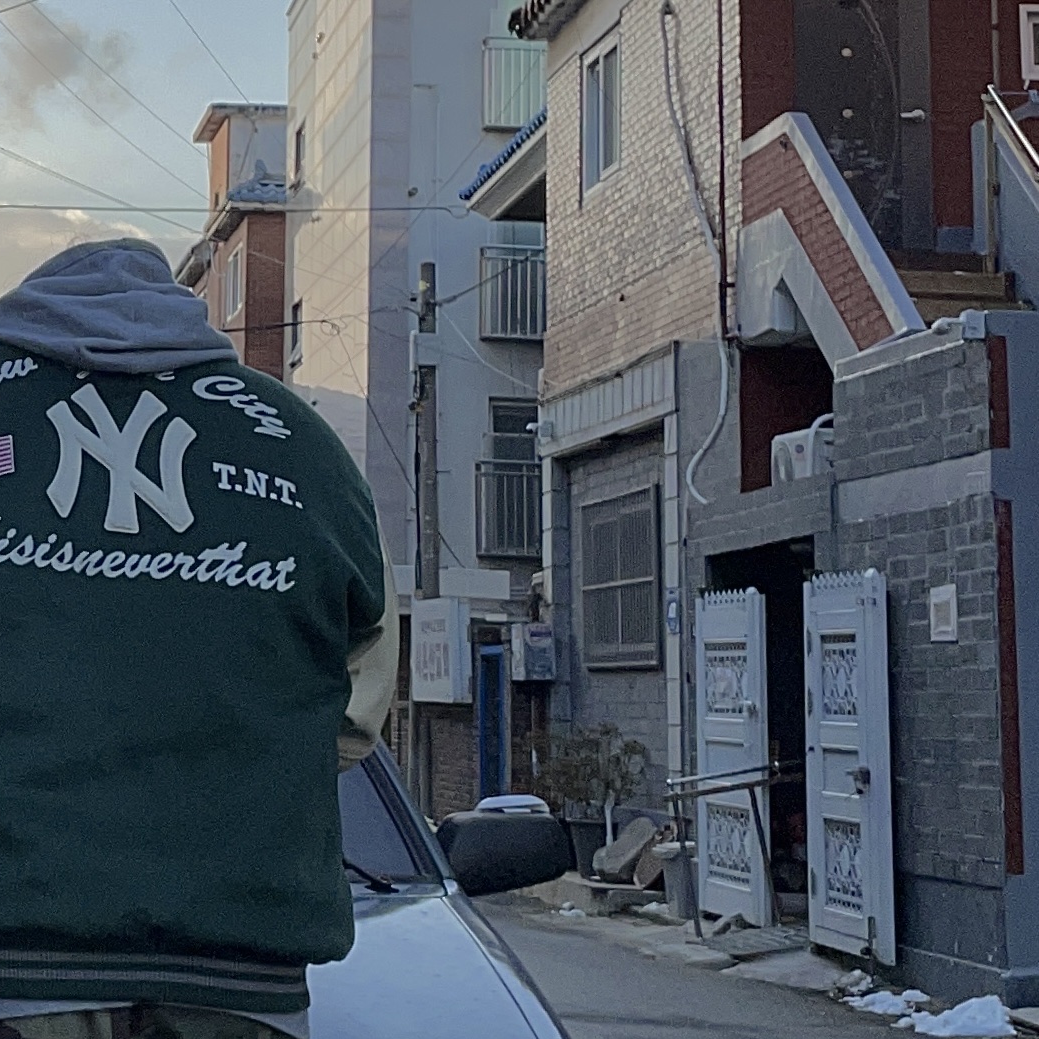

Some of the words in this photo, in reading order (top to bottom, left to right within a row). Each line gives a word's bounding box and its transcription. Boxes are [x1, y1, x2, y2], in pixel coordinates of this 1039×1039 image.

[192, 375, 292, 440] City
[46, 383, 197, 534] NY
[212, 461, 304, 509] T.N.T.
